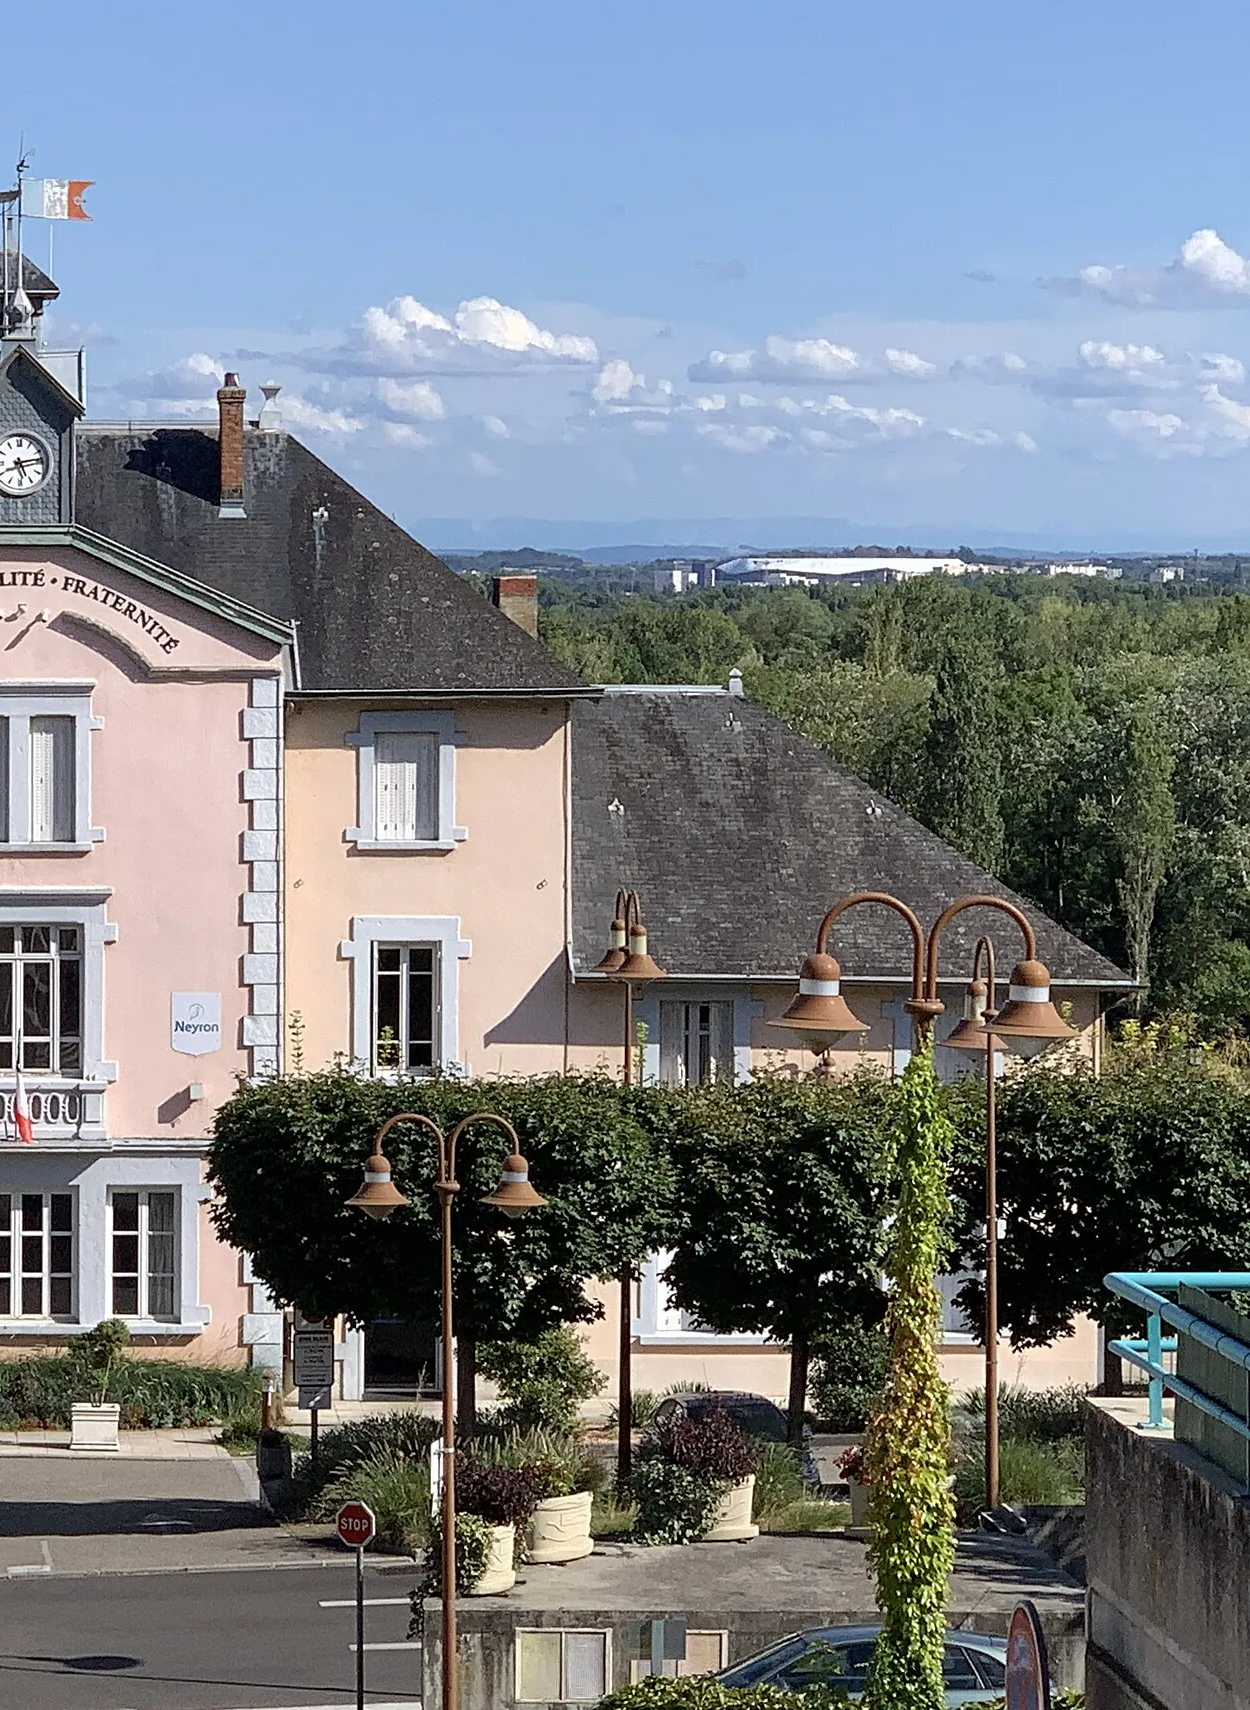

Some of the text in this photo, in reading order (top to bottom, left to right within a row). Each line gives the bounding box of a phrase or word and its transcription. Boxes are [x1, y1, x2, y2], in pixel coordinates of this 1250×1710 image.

[61, 576, 181, 655] FRATERNITÉ
[174, 1021, 218, 1034] Neyron
[340, 1517, 369, 1531] STOP
